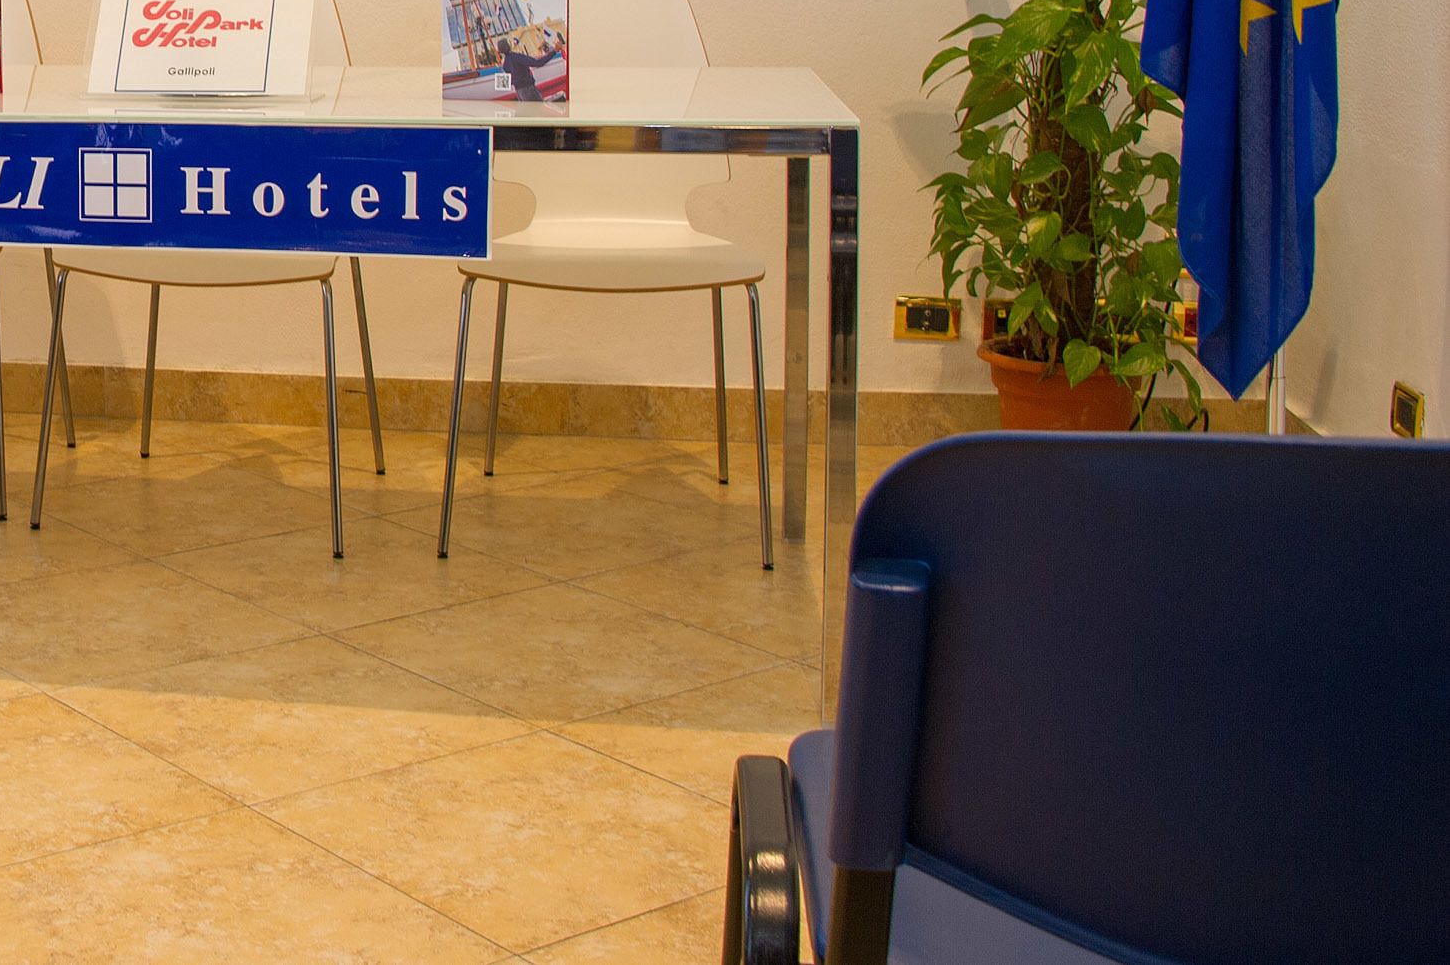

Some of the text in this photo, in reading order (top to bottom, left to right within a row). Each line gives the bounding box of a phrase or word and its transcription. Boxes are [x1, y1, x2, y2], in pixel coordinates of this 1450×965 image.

[185, 10, 264, 34] Park
[132, 23, 217, 48] Hotel
[167, 66, 216, 77] Gallipoli
[179, 166, 468, 222] Hotels
